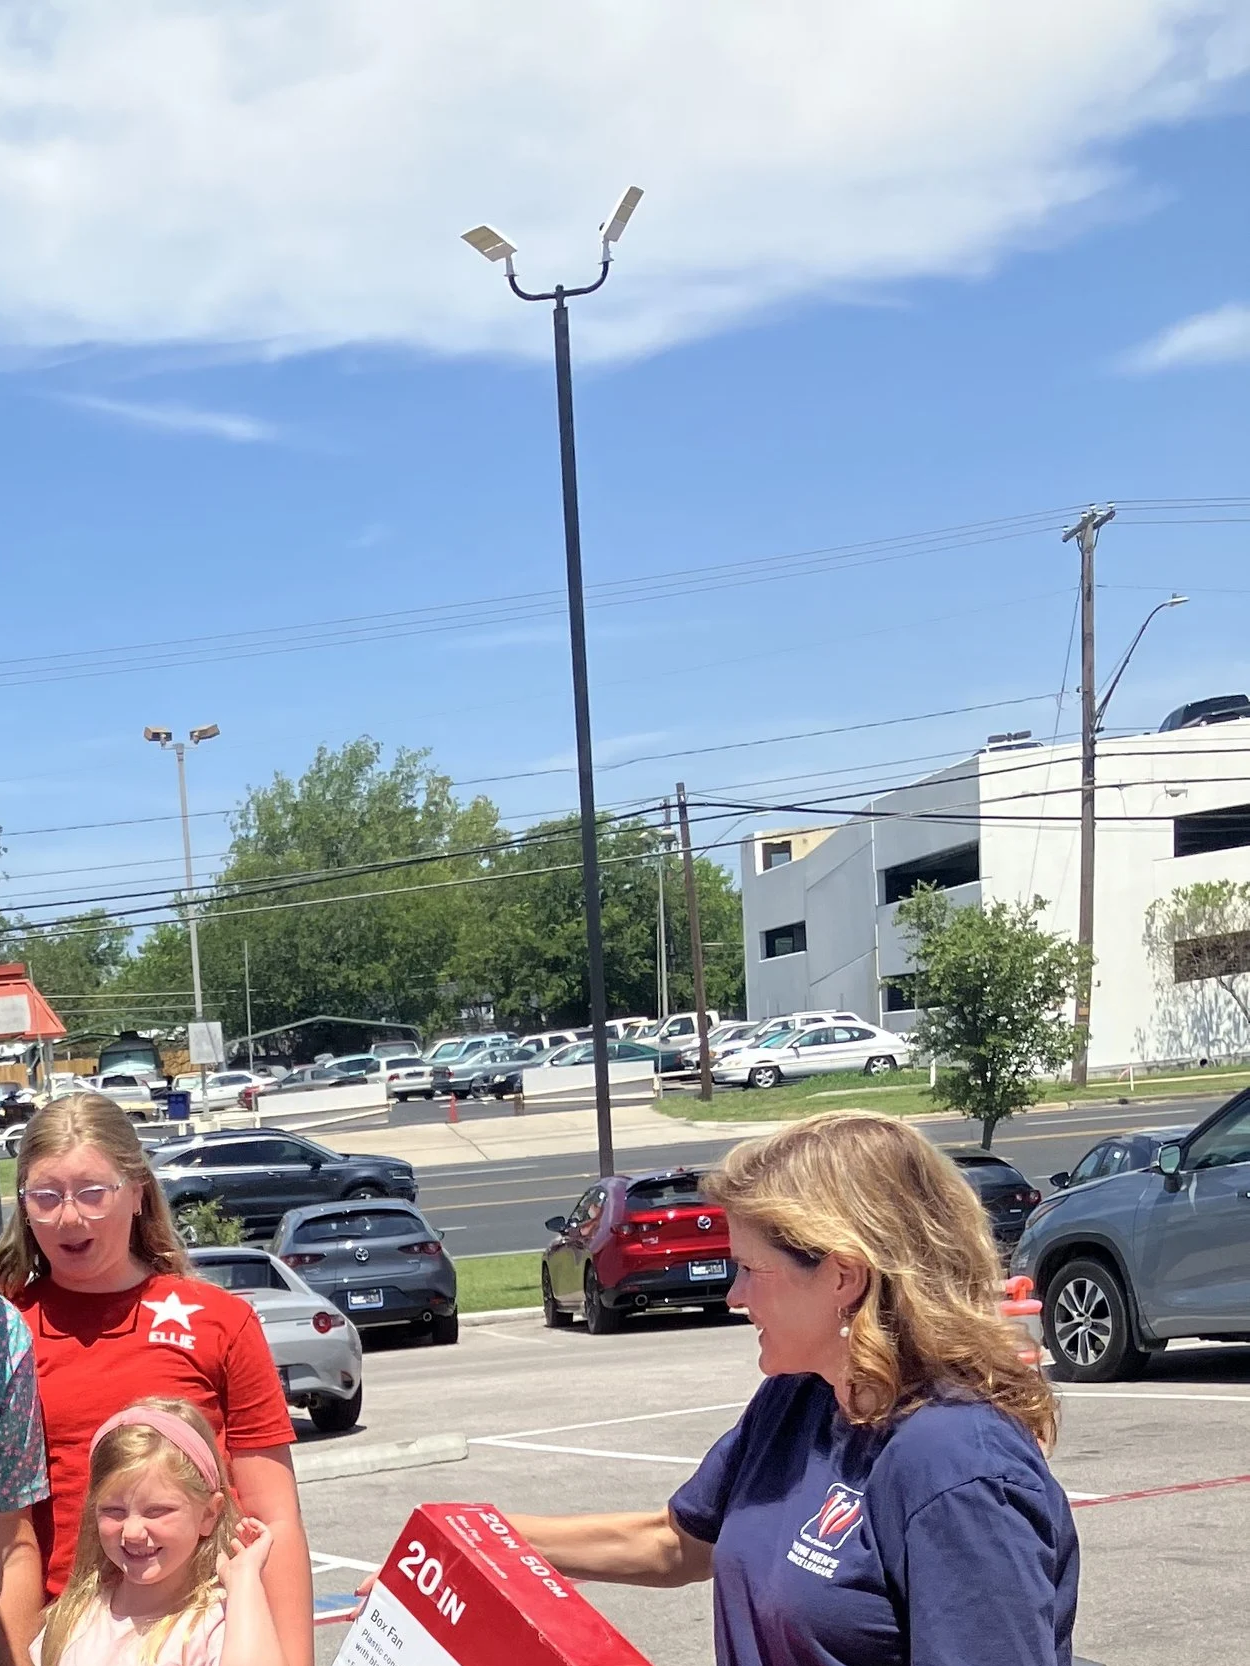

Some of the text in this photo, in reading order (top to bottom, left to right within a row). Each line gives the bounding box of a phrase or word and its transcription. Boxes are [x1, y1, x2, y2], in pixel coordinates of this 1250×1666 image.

[148, 1331, 196, 1350] ELLIE
[478, 1512, 569, 1598] 20 IN 50 CM
[397, 1540, 467, 1626] 20 IN
[362, 1628, 384, 1656] Plastic
[370, 1608, 404, 1650] Box Fan
[355, 1642, 370, 1660] with
